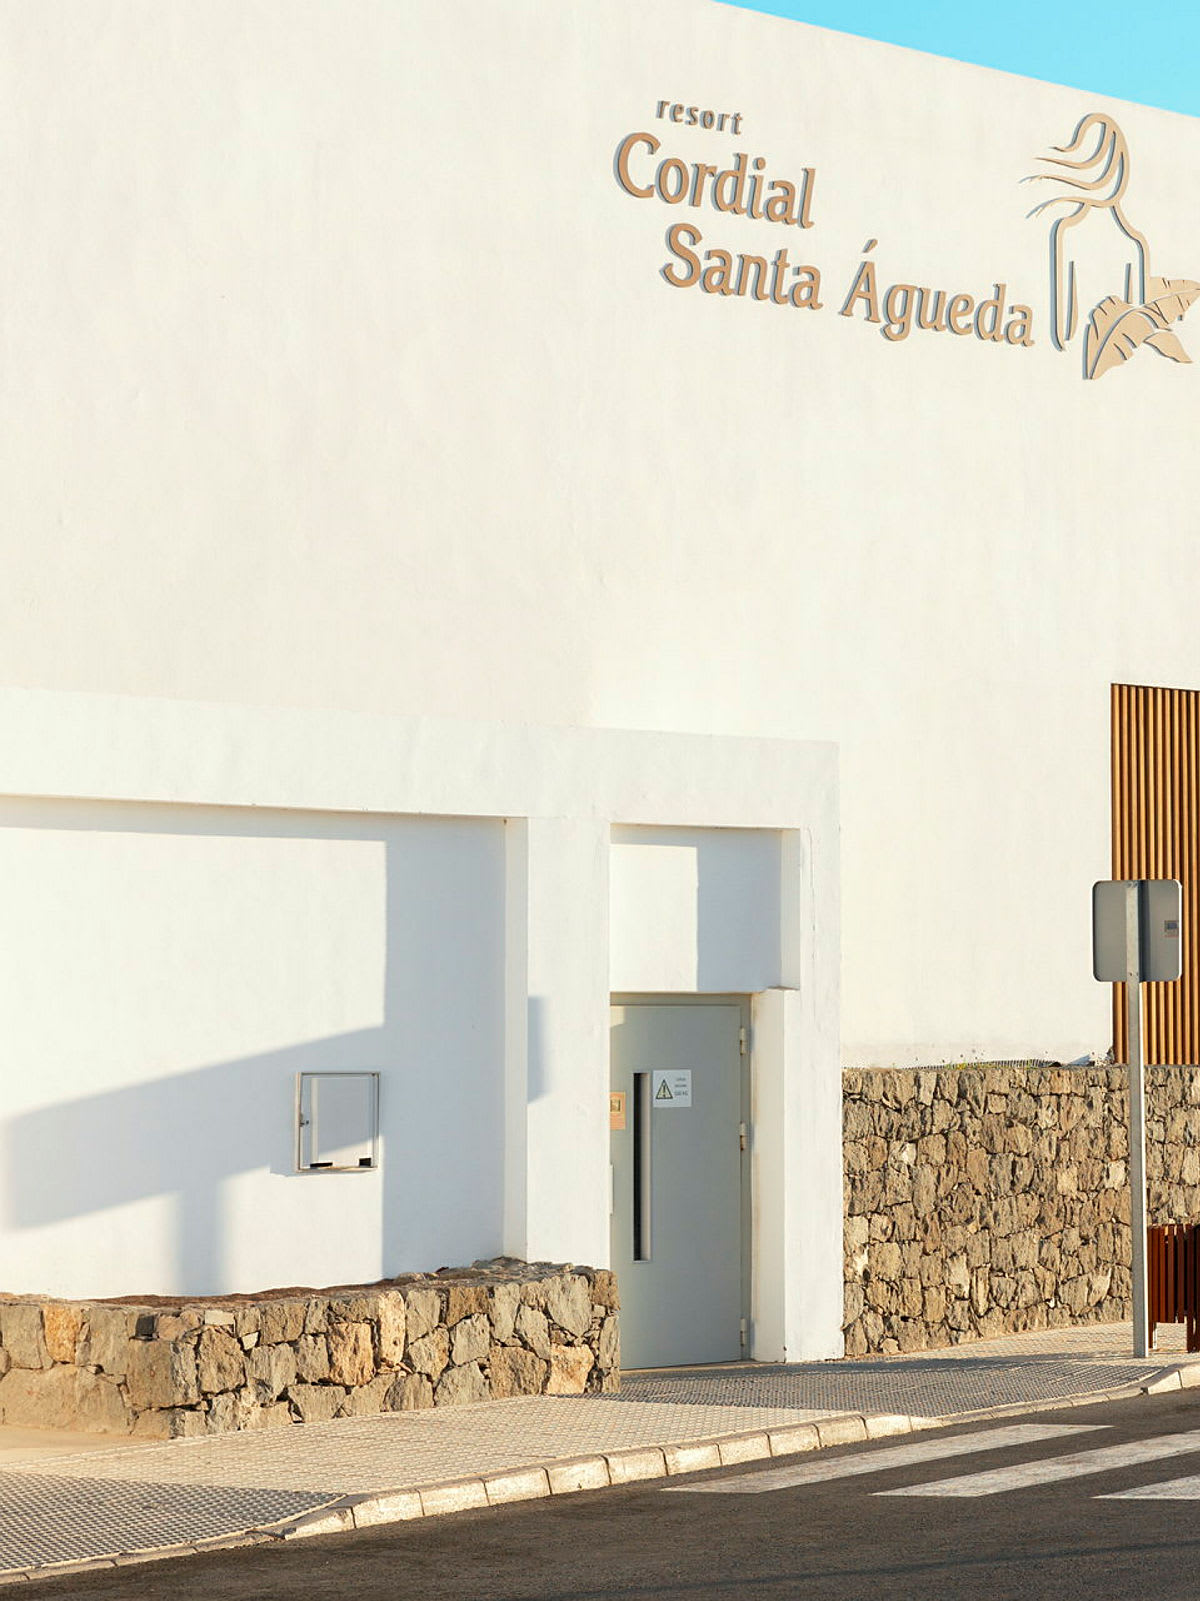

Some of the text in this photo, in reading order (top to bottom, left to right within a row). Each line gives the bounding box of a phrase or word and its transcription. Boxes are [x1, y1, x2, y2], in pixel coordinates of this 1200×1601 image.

[656, 99, 743, 135] resort
[613, 132, 817, 229] Cordial
[659, 222, 1036, 347] Santa Águeda
